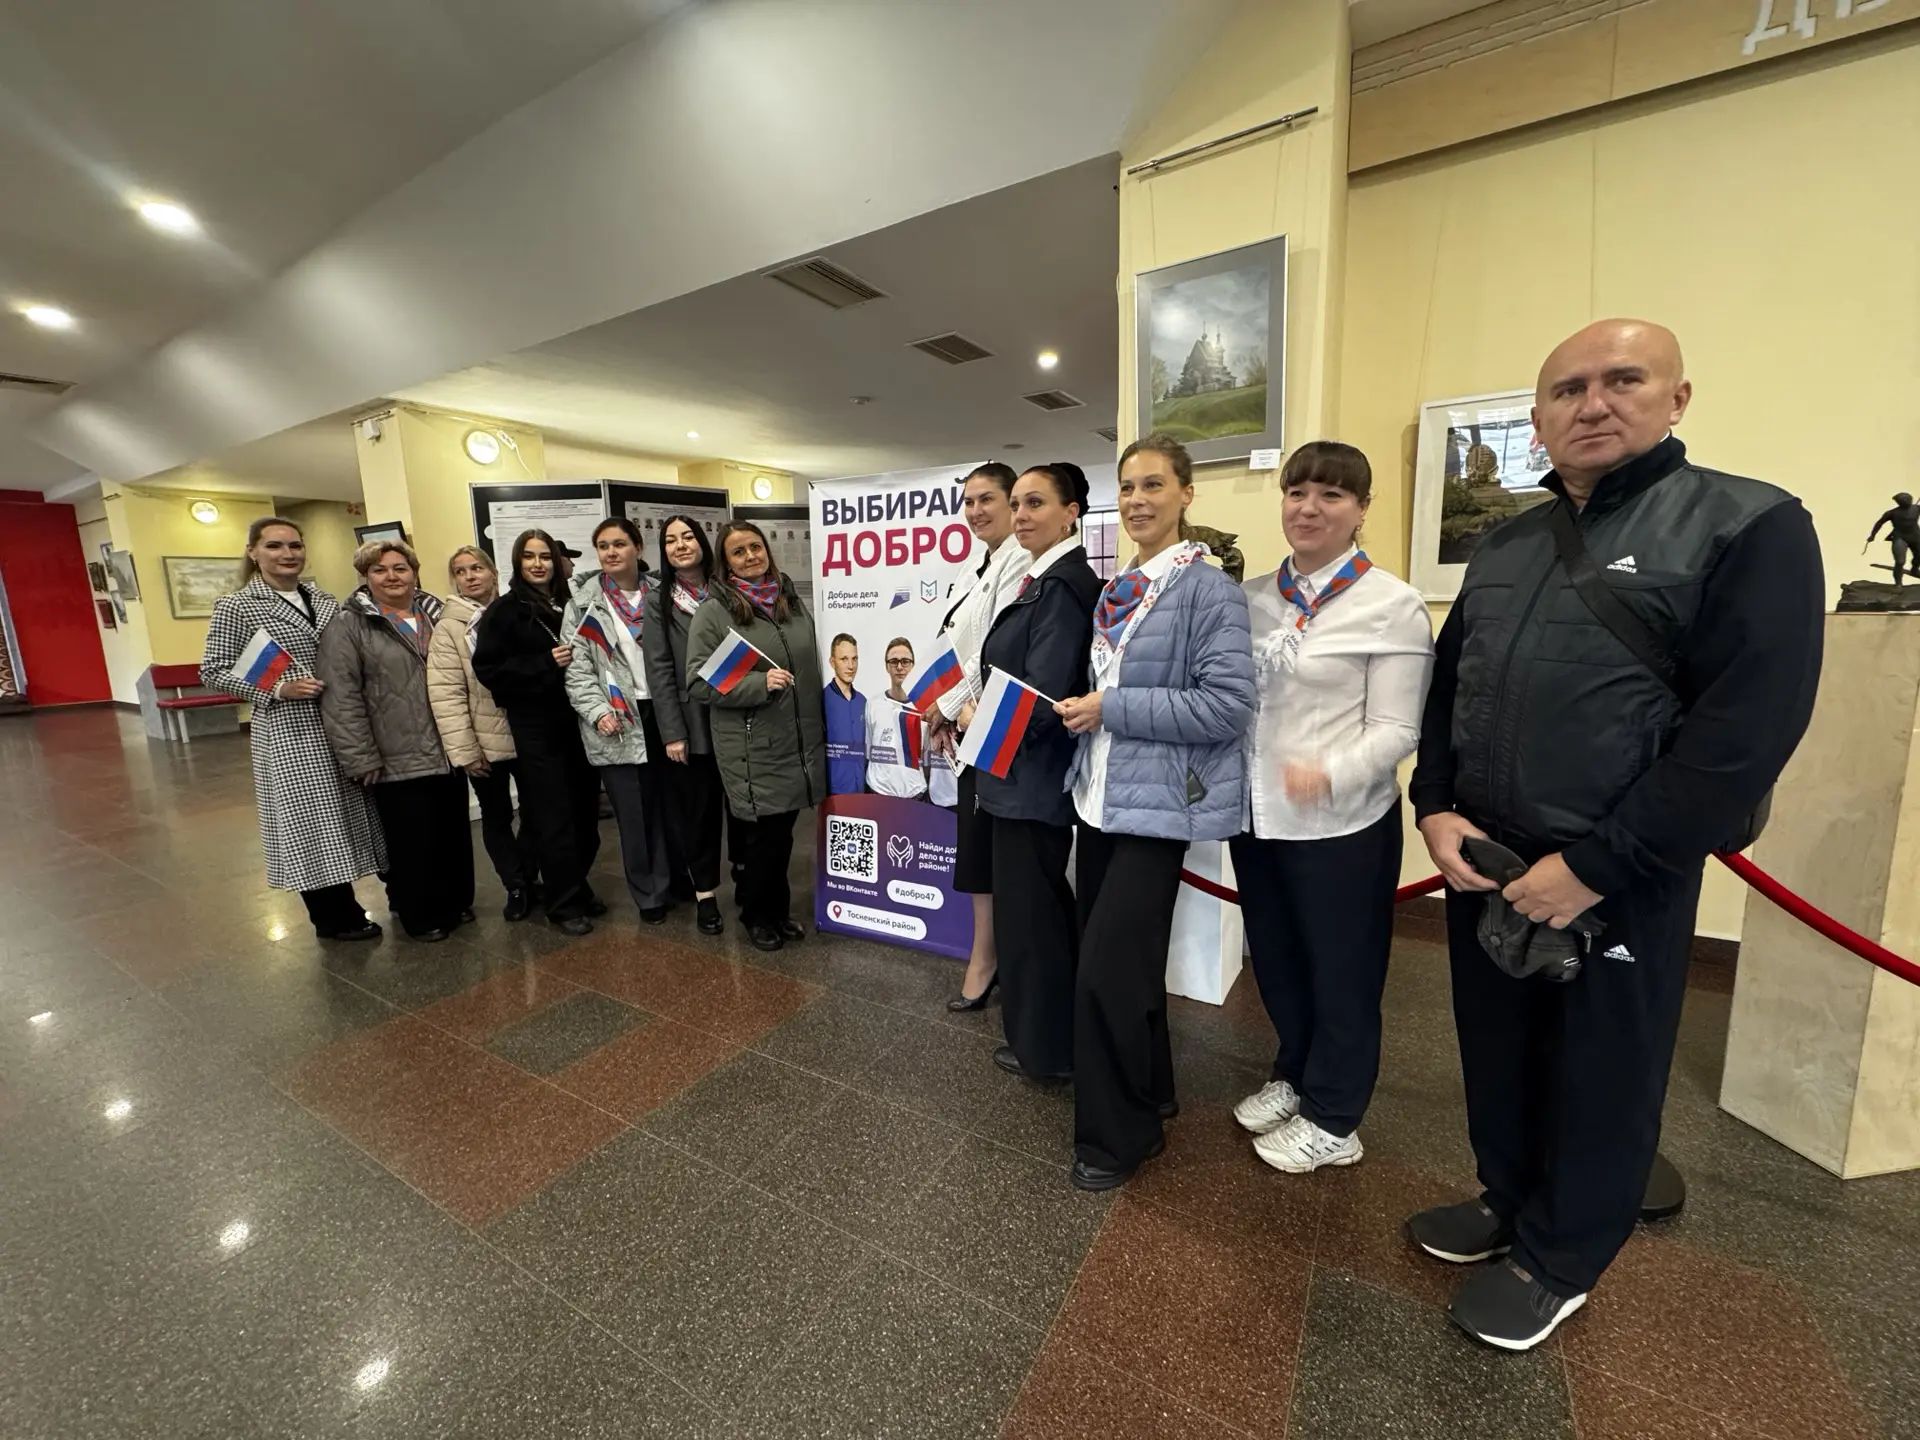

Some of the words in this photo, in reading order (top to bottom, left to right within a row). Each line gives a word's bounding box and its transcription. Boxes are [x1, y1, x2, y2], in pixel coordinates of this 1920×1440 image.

[822, 523, 972, 577] ДОБРО
[1606, 564, 1637, 574] adidas
[828, 591, 858, 600] Добрые
[860, 591, 879, 599] дела
[828, 601, 876, 609] объединяют
[919, 841, 944, 853] Найди
[919, 852, 938, 861] дело
[919, 862, 950, 873] районе!
[827, 881, 837, 889] Мы
[846, 884, 879, 897] ВКонтакте
[895, 887, 936, 902] #добро47
[847, 910, 891, 927] Тосненский
[892, 918, 917, 931] район
[1603, 951, 1636, 963] adidas
